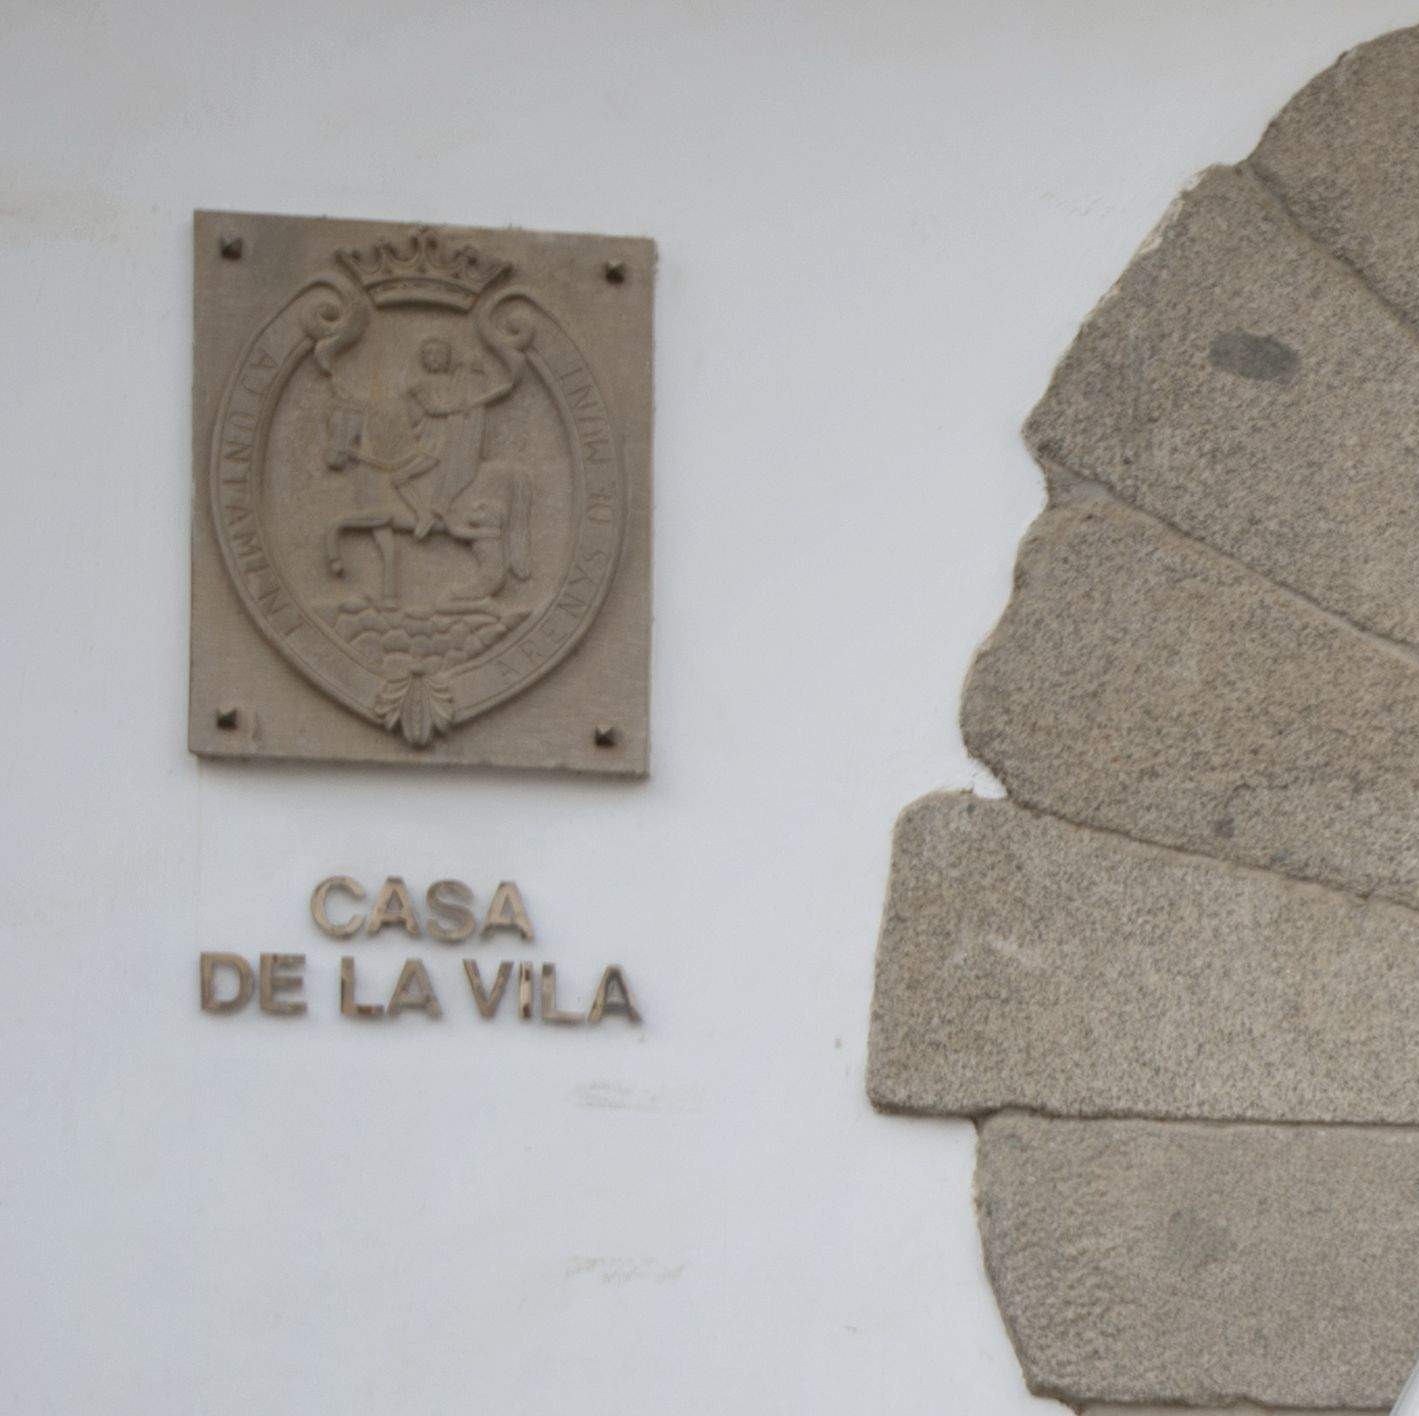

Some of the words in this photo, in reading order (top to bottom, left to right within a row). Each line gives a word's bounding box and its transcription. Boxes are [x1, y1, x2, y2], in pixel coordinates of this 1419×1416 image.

[310, 875, 534, 943] CASA
[199, 952, 308, 1017] DE
[340, 956, 443, 1019] LA
[462, 957, 641, 1024] VILA
